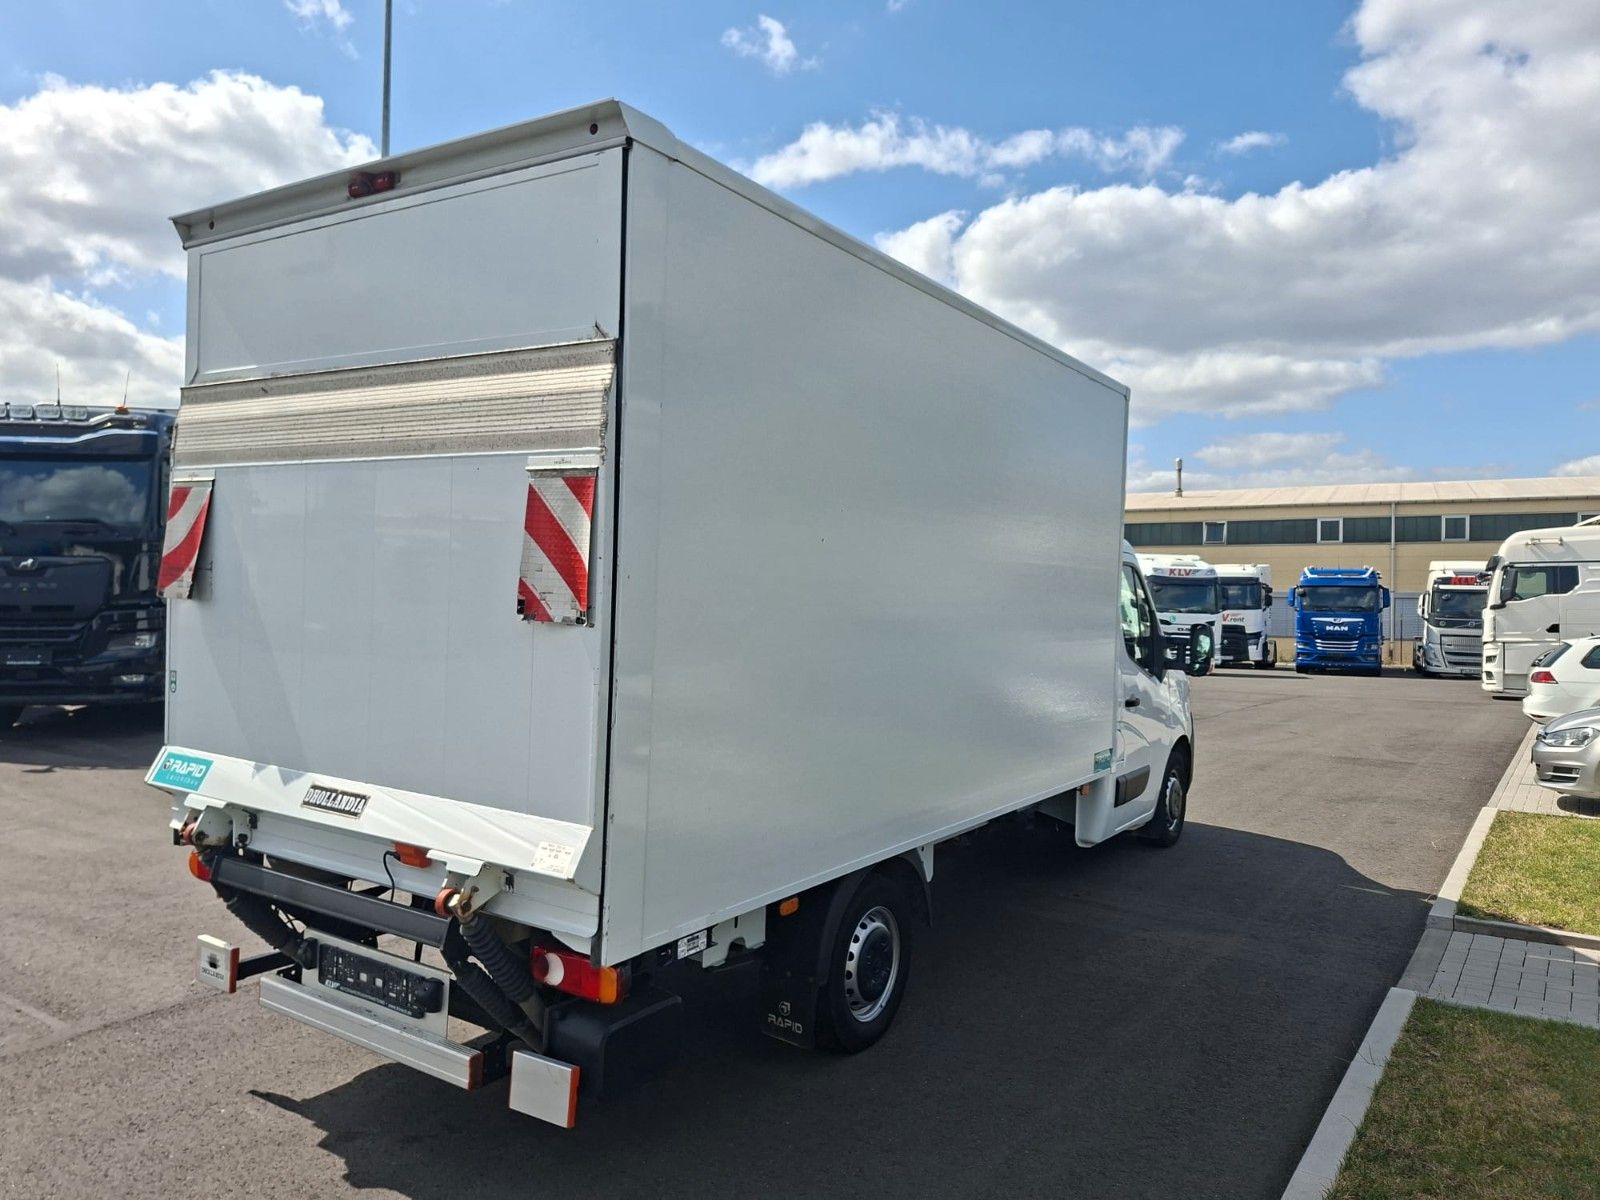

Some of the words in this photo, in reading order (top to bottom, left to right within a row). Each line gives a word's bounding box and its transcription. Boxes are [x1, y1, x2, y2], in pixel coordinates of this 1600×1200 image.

[1169, 568, 1193, 577] KLV
[171, 759, 207, 778] RAPID
[303, 788, 366, 813] DHOLLANDIA
[767, 1013, 803, 1034] RAPID
